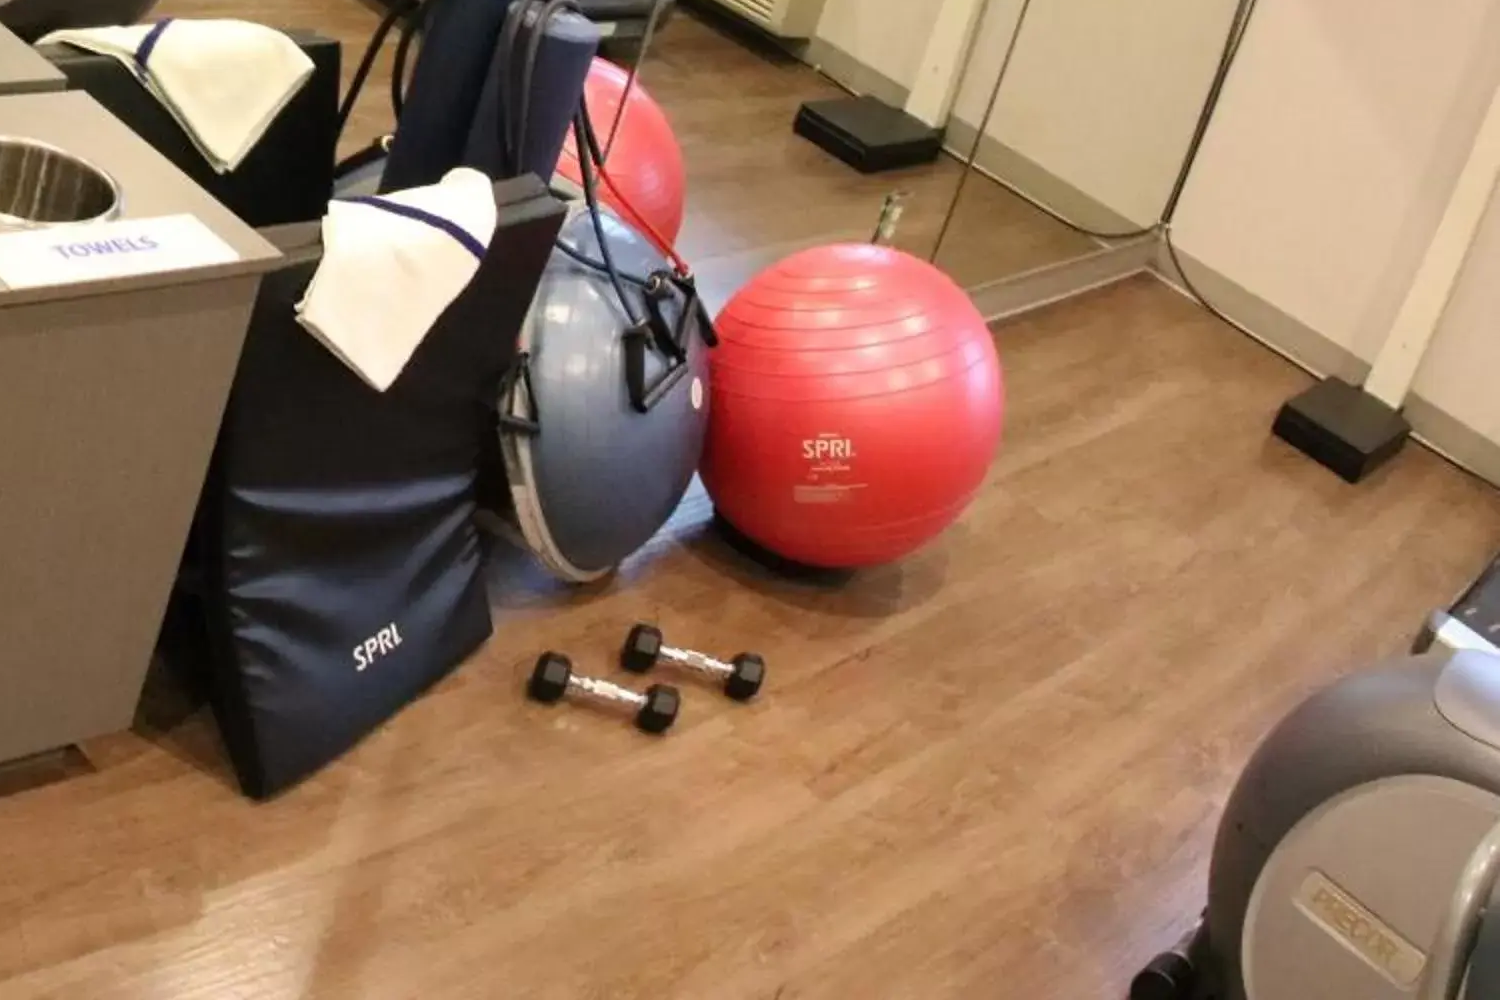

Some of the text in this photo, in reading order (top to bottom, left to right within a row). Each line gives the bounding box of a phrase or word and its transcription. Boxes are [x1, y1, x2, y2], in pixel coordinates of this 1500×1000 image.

[51, 235, 160, 260] TOWELS
[802, 438, 852, 459] SPRI
[352, 621, 402, 672] SPRI
